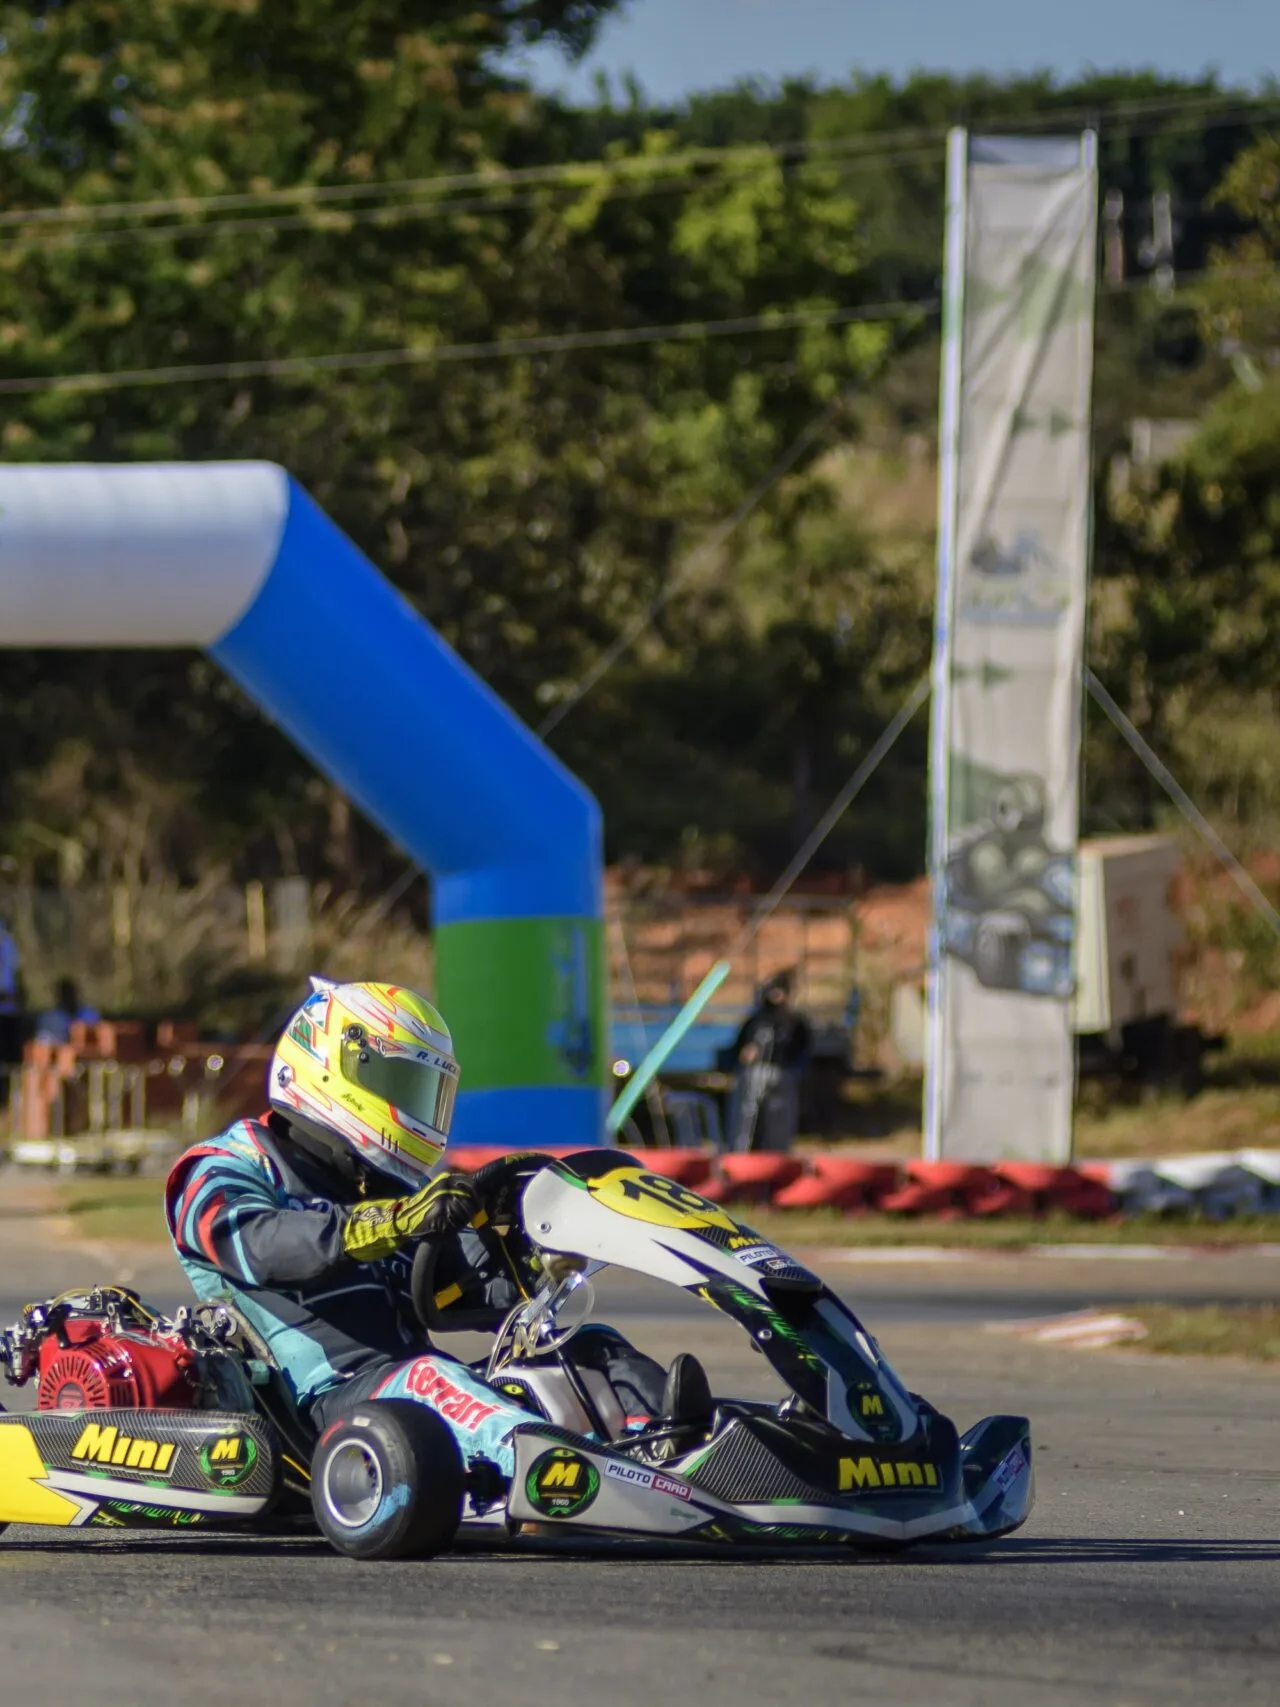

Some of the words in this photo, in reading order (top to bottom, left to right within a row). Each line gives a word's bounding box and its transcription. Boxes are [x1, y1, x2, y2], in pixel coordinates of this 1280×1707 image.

[619, 1174, 719, 1214] 18
[861, 1395, 884, 1415] M
[71, 1423, 175, 1472] Mini
[210, 1437, 241, 1461] M
[541, 1461, 581, 1488] M
[608, 1464, 652, 1484] PILOTO
[837, 1456, 939, 1491] Mini
